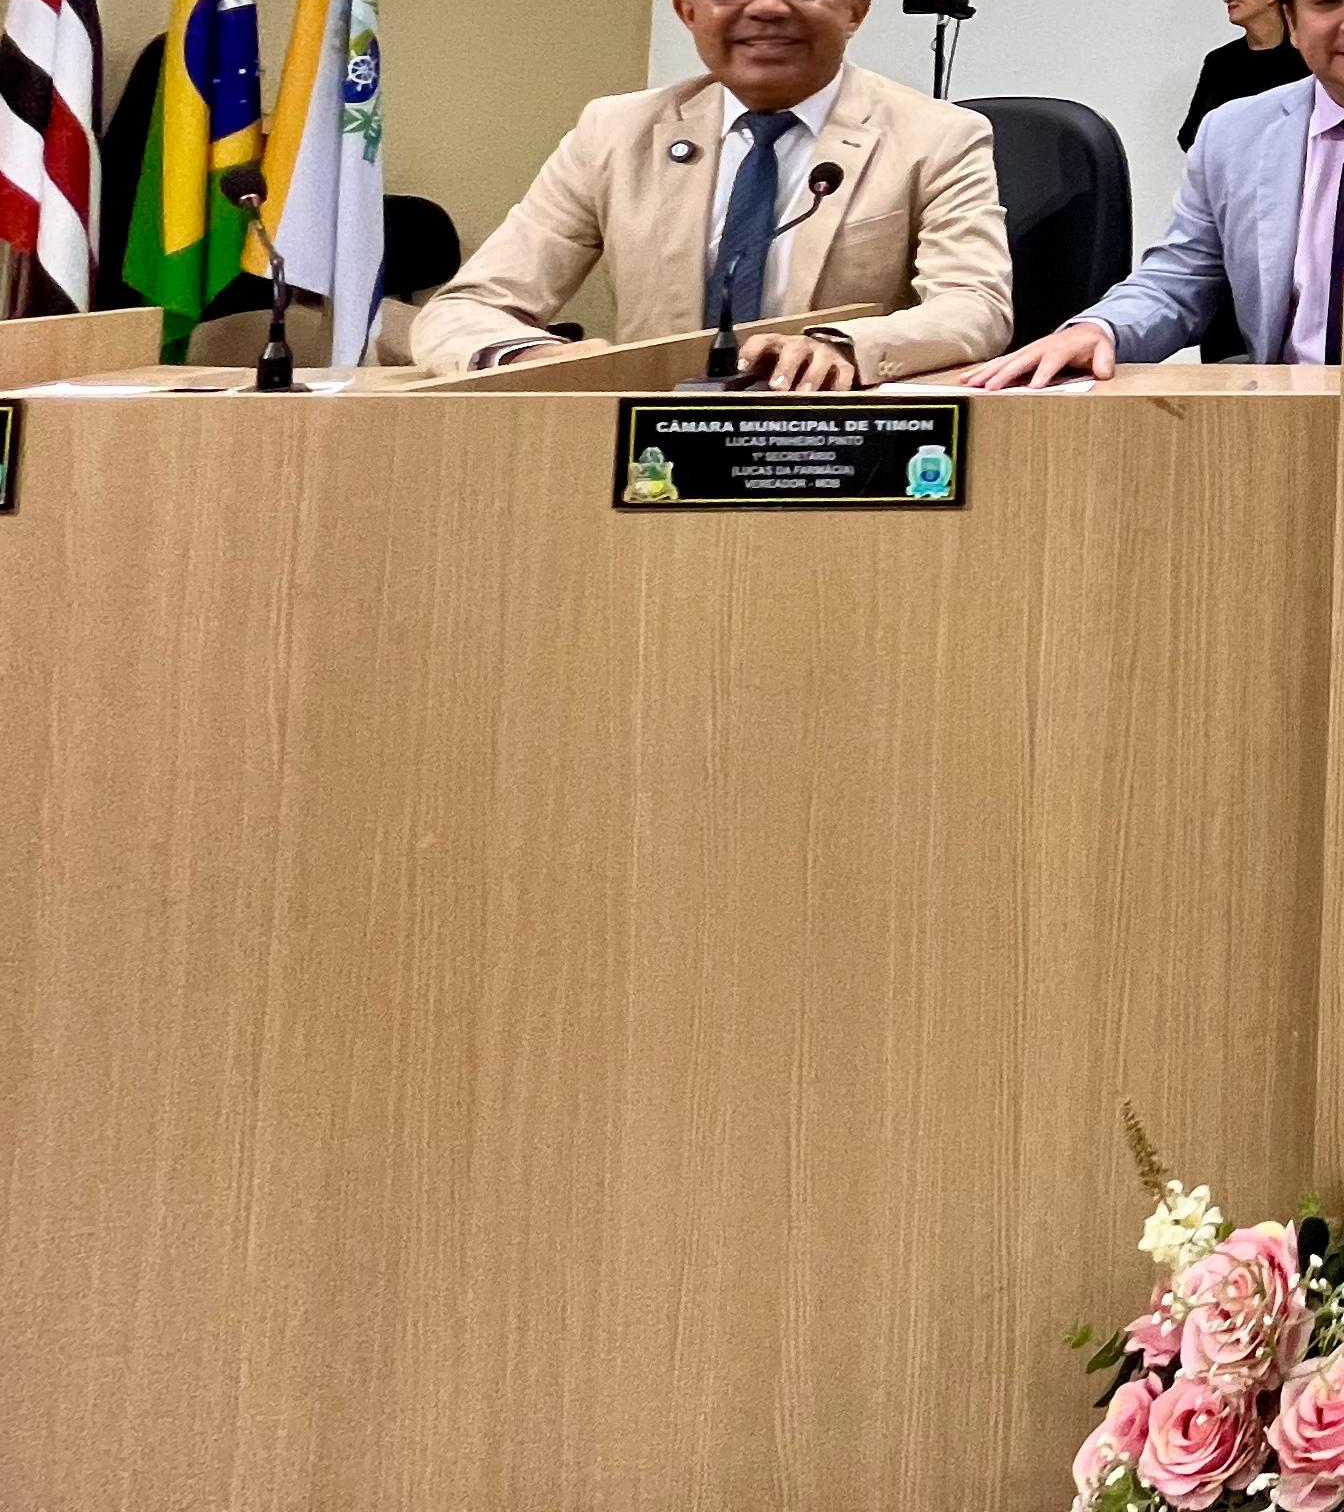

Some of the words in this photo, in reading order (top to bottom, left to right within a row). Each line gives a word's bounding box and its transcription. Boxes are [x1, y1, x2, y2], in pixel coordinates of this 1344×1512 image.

[655, 419, 734, 433] CÂMARA
[738, 420, 841, 433] MUNICIPAL
[845, 420, 870, 432] DE
[874, 419, 935, 432] TIMON
